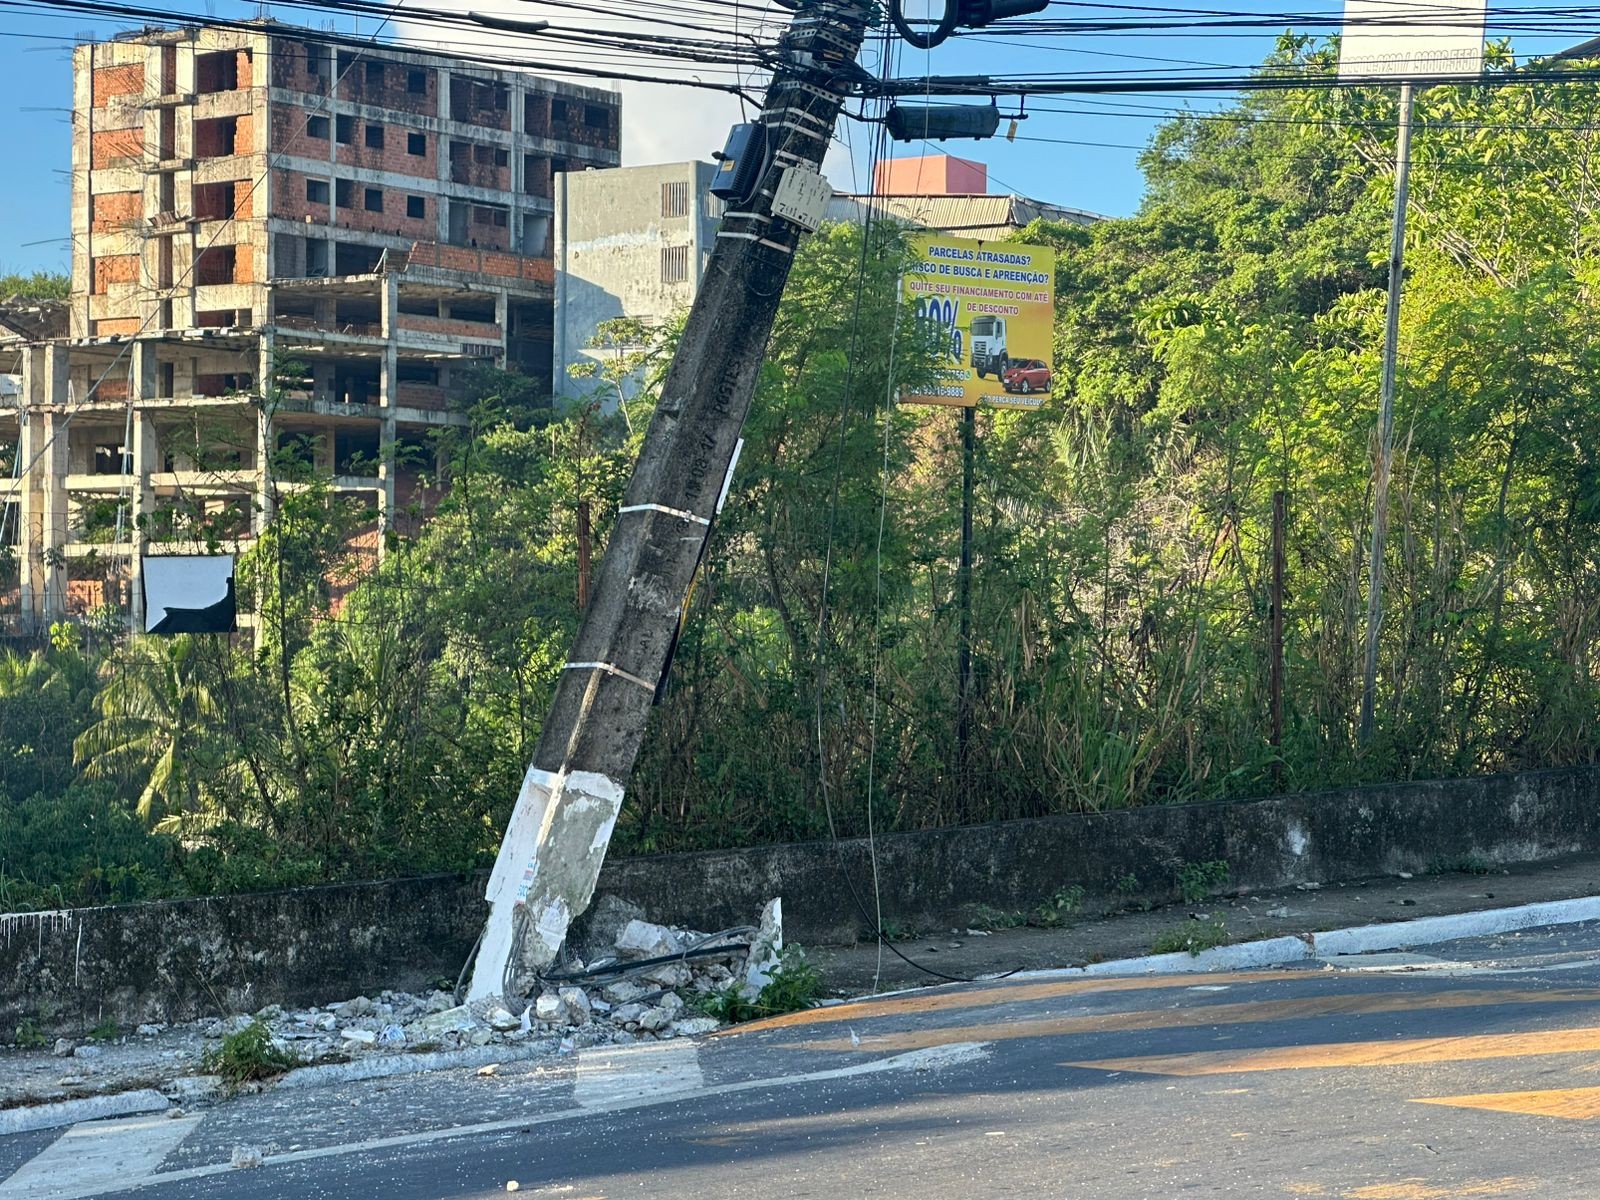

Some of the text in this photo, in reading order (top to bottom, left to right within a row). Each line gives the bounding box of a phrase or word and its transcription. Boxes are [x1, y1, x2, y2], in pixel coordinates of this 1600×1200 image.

[928, 246, 1031, 266] PARCELAS ATRASADAS?
[939, 264, 951, 275] DE
[953, 265, 982, 278] BUSCA
[985, 268, 991, 279] E
[992, 268, 1049, 285] APREENÇÃO?
[910, 281, 1049, 302] QUITE SEU FINANCIAMENTO COM ATÉ
[966, 302, 1019, 315] DE DESCONTO
